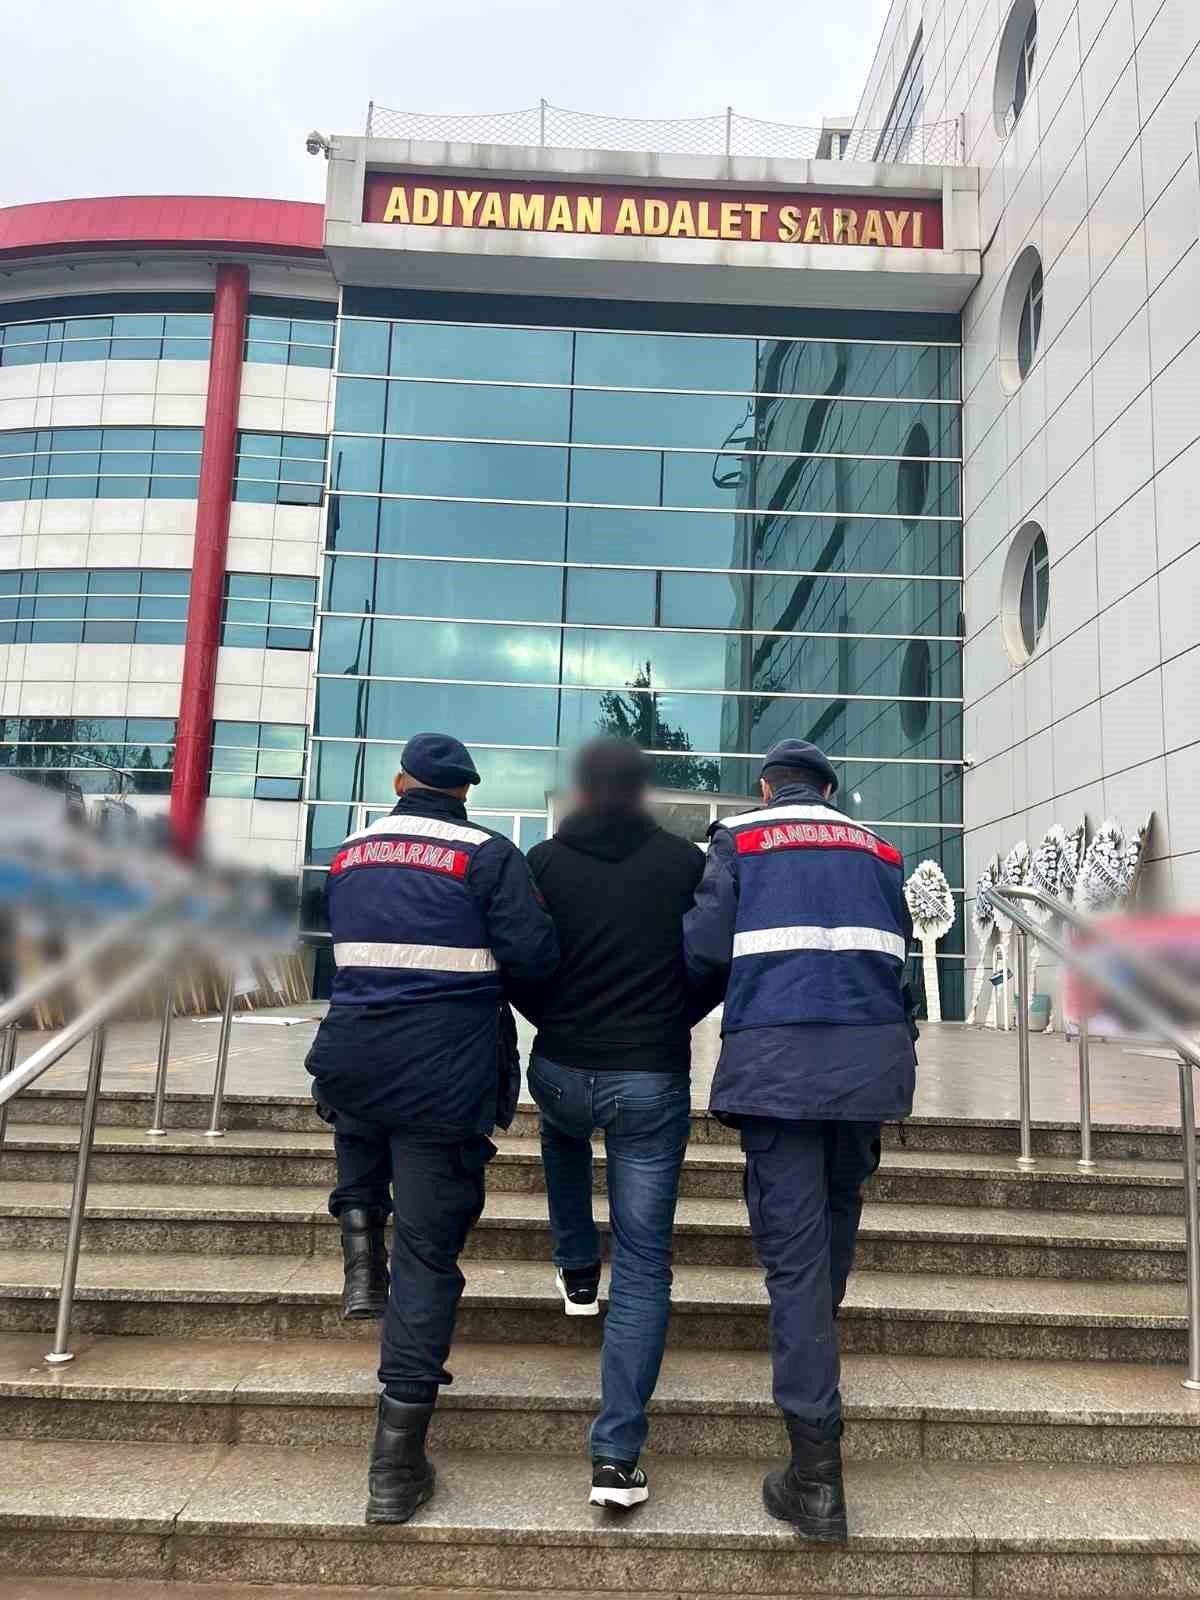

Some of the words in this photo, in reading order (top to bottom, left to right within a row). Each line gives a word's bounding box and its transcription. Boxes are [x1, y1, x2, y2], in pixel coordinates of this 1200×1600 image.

[383, 187, 602, 233] ADIYAMAN
[614, 198, 769, 241] ADALET
[778, 206, 924, 248] SARAYI
[760, 823, 879, 853] JANDARMA
[342, 841, 457, 871] JANDARMA
